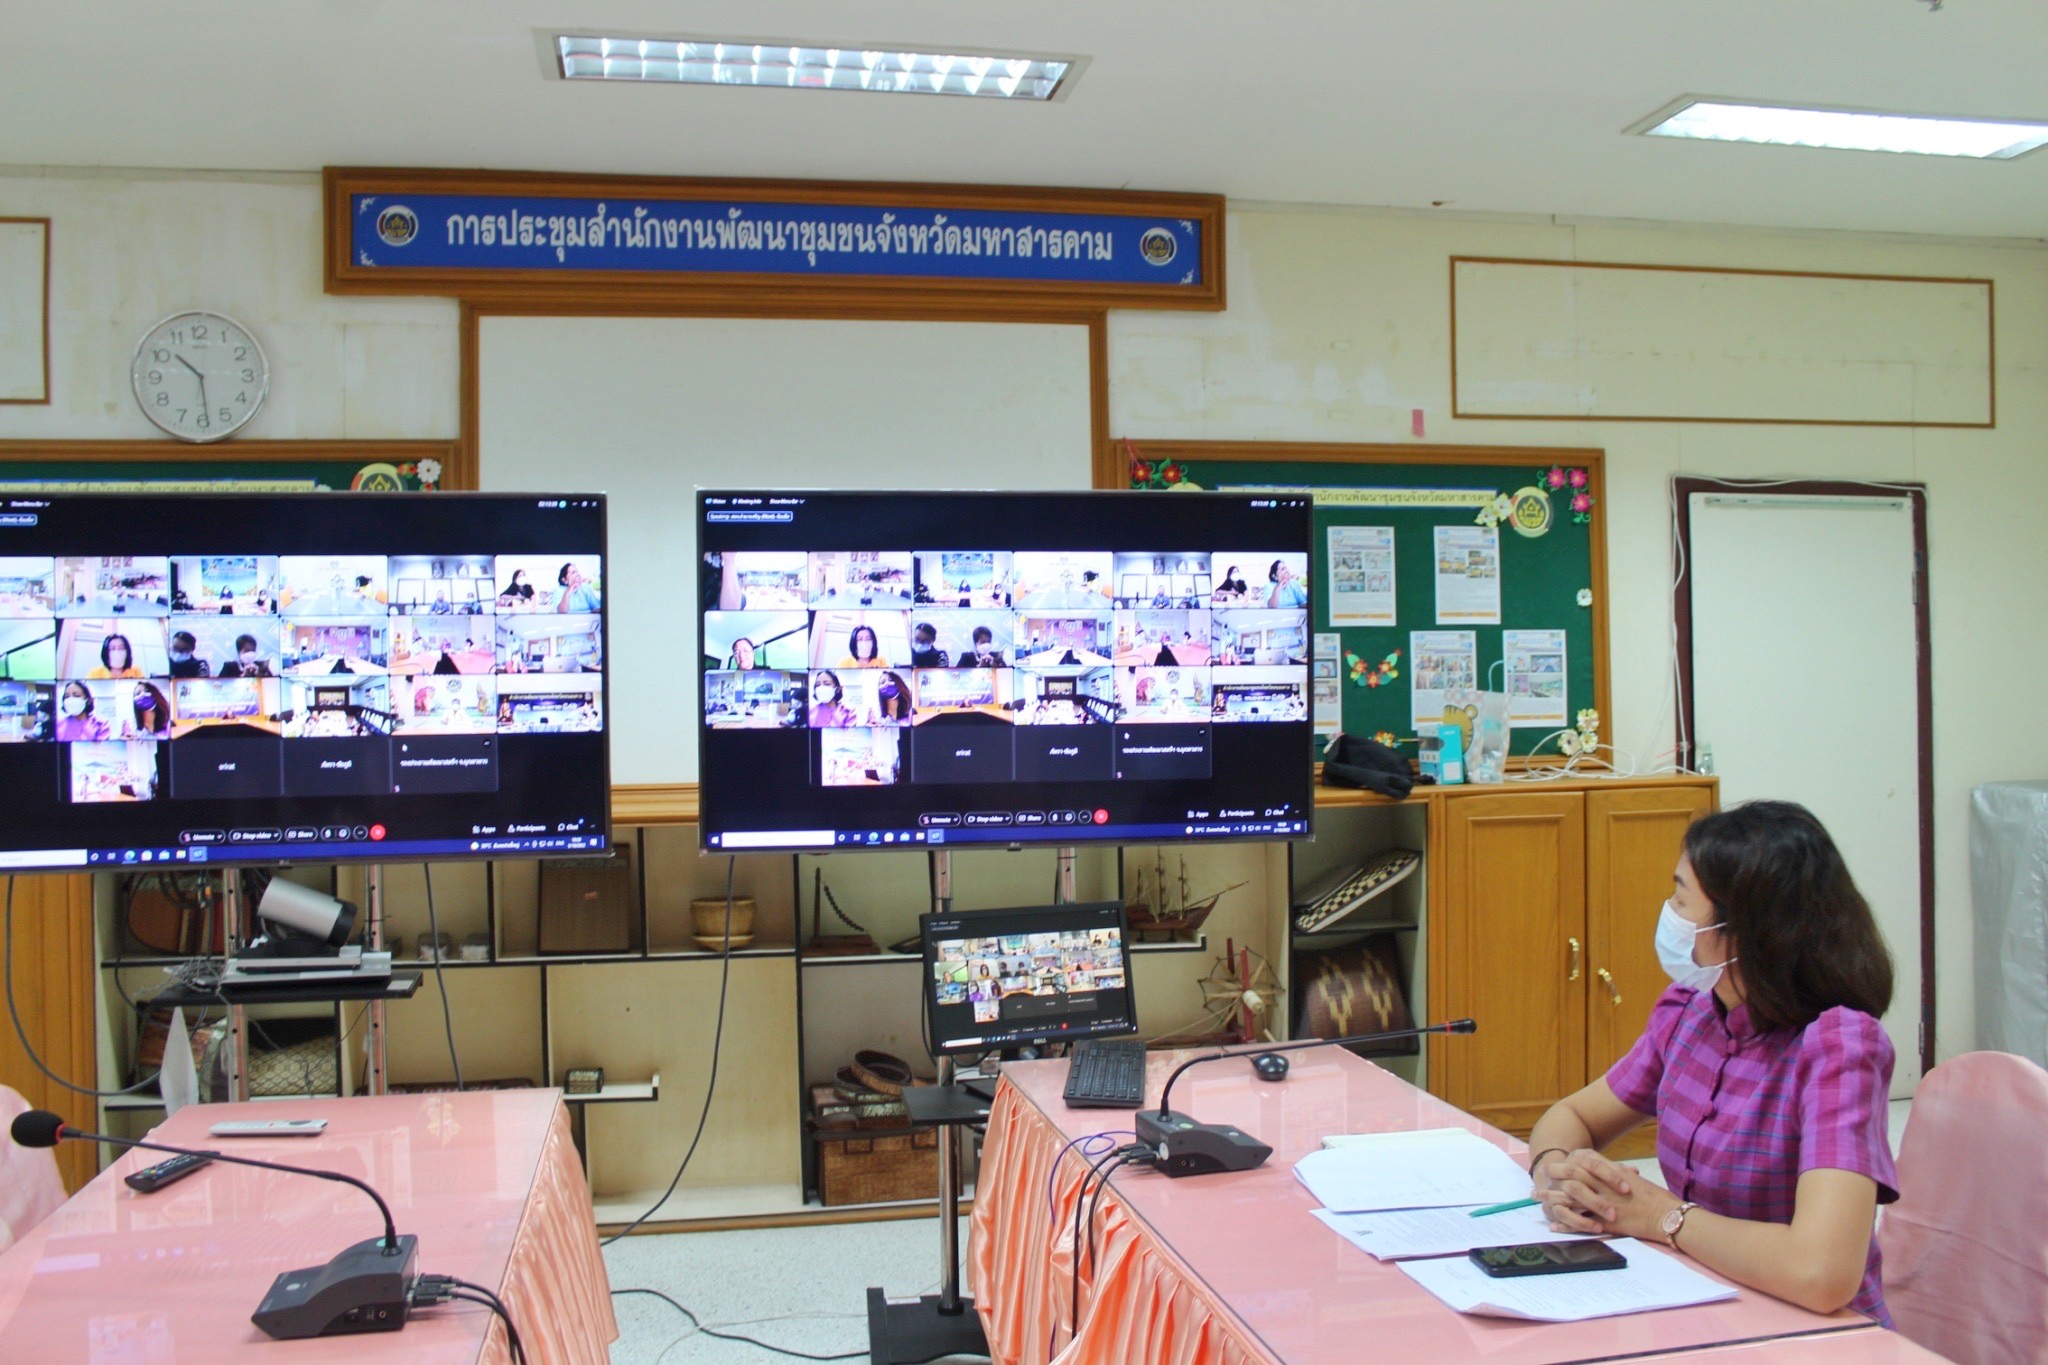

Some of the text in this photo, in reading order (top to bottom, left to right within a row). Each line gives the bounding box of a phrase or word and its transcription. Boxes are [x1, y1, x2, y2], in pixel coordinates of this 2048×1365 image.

[446, 202, 1113, 267] การประชุมสำนักงานพัฒนาชุมชนจังหวัดมหาสารคาม
[170, 331, 183, 345] 11
[191, 325, 207, 340] 12
[221, 331, 227, 344] 1
[153, 348, 171, 363] 10
[233, 346, 247, 361] 2
[148, 370, 162, 385] 9
[241, 368, 255, 384] 3
[156, 391, 169, 406] 8
[235, 391, 247, 404] 4
[176, 408, 188, 423] 7
[196, 413, 210, 428] 6
[219, 407, 232, 422] 5
[1033, 1037, 1047, 1045] DELL
